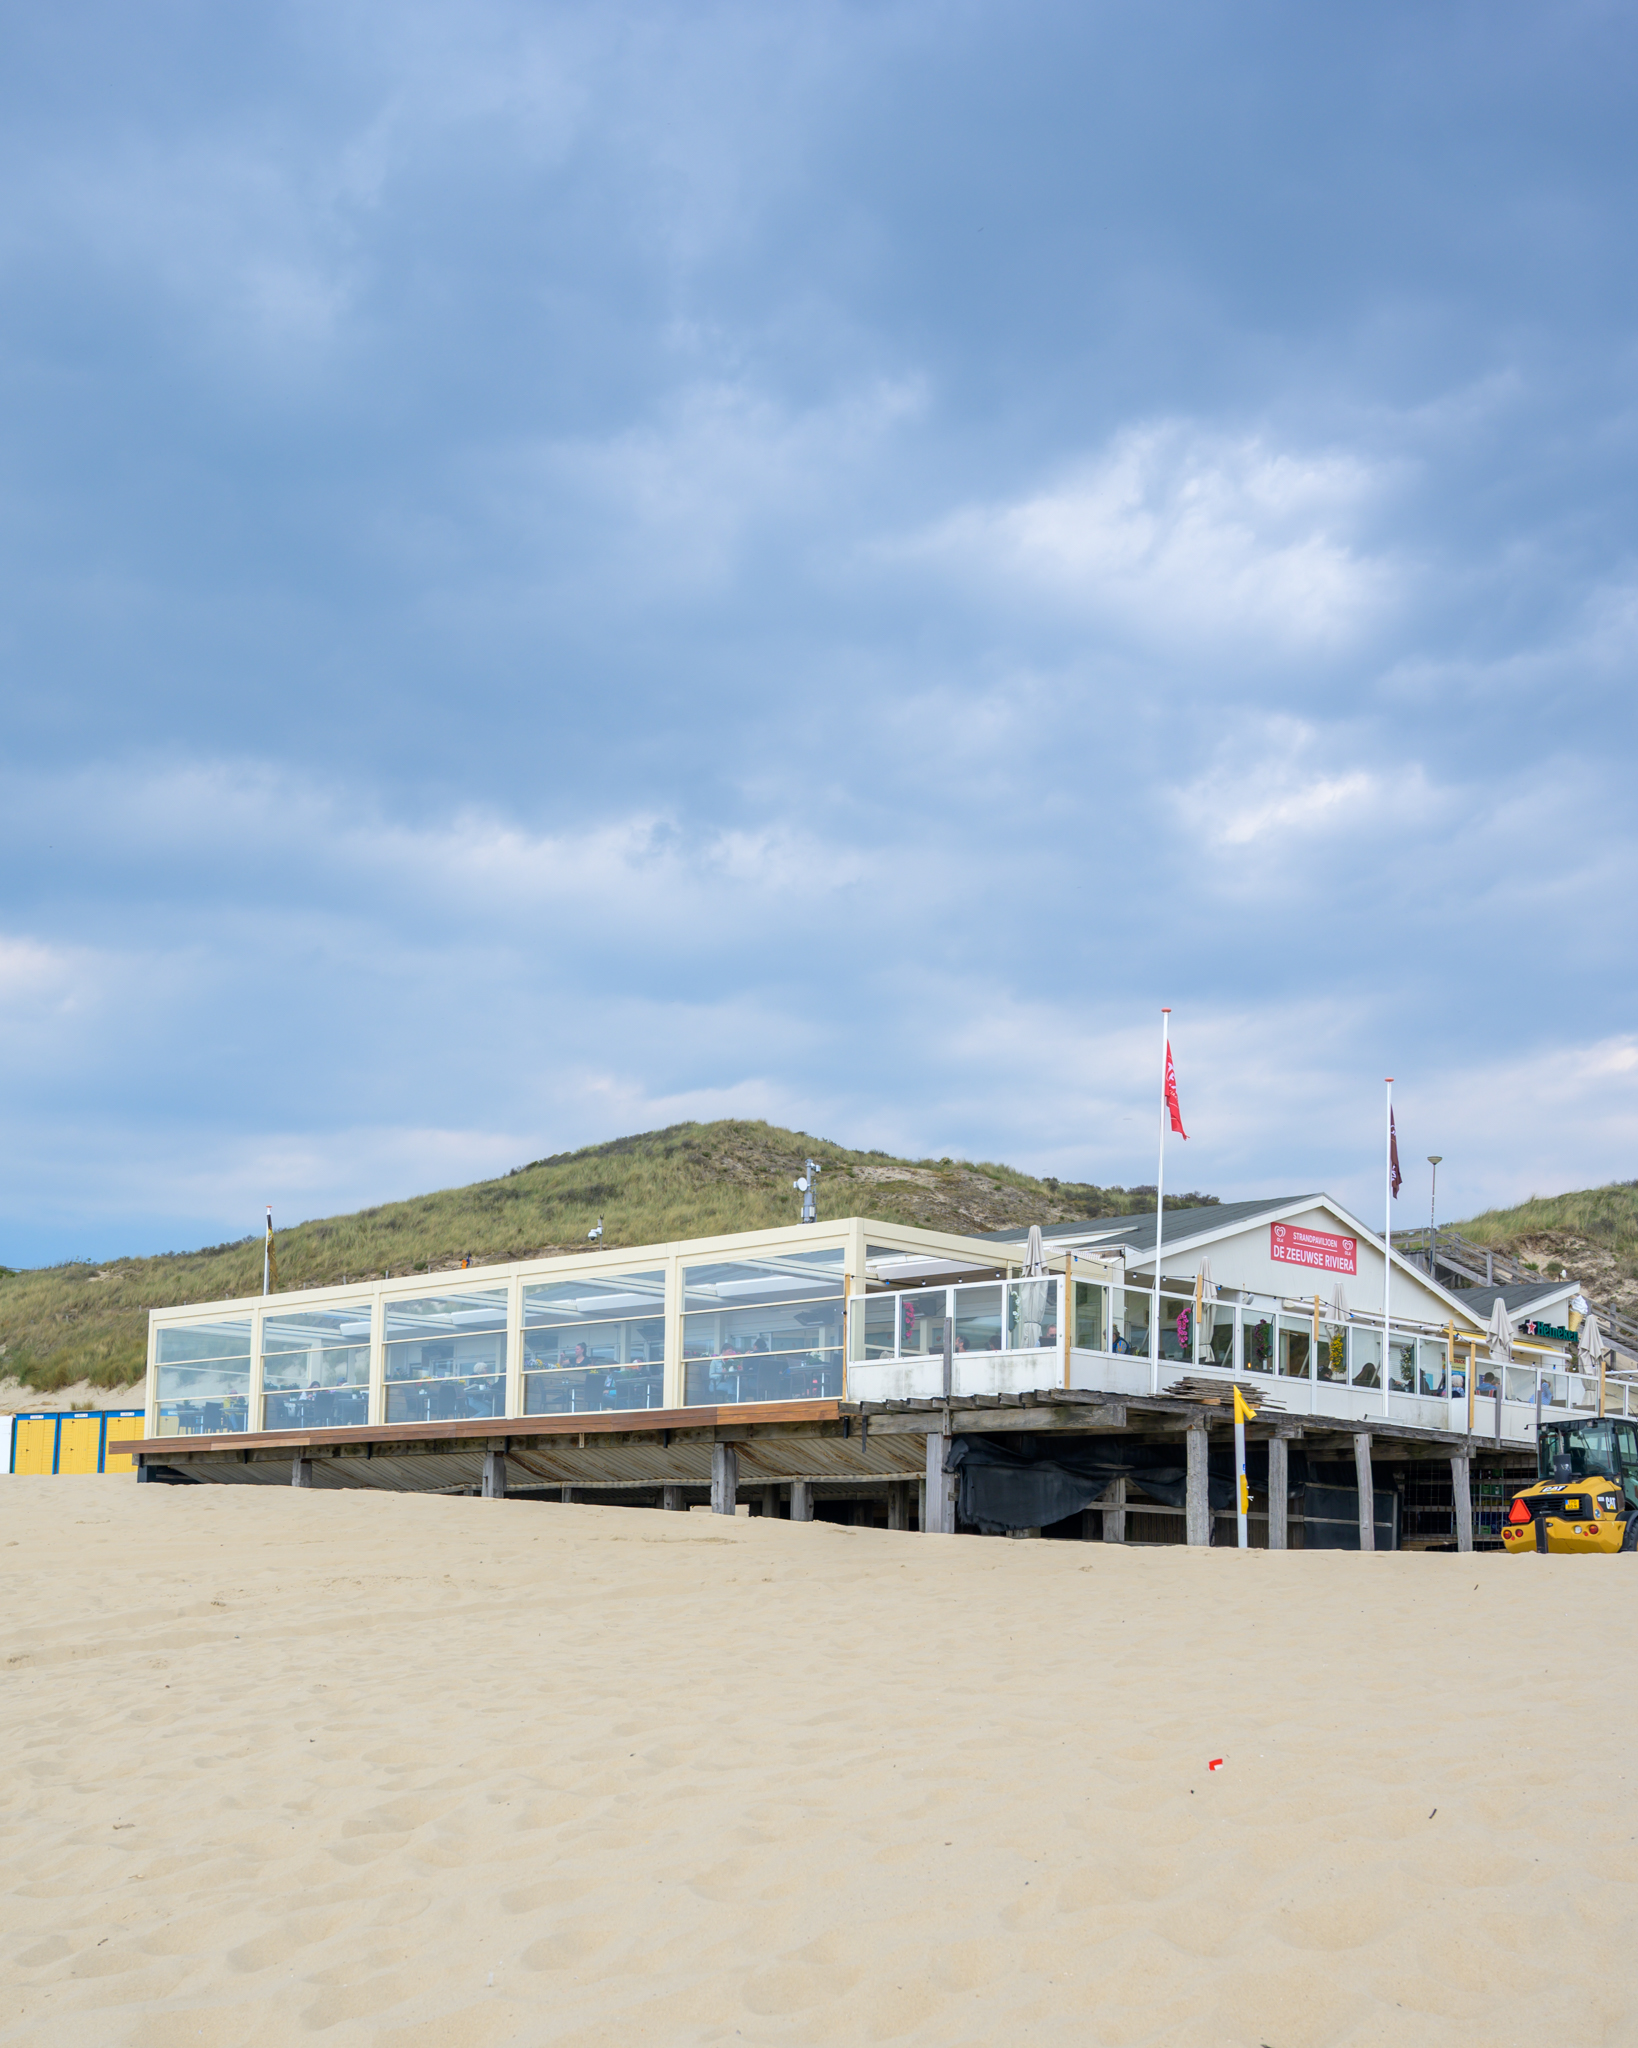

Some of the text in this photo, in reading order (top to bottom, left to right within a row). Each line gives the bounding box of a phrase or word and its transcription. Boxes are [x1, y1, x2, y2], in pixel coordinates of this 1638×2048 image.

[1292, 1232, 1338, 1247] STRANDPAVILJOEN
[1273, 1245, 1354, 1271] DE ZEEUWSE RIVIERA
[1537, 1321, 1579, 1342] Heineken
[1606, 1497, 1617, 1509] CAT
